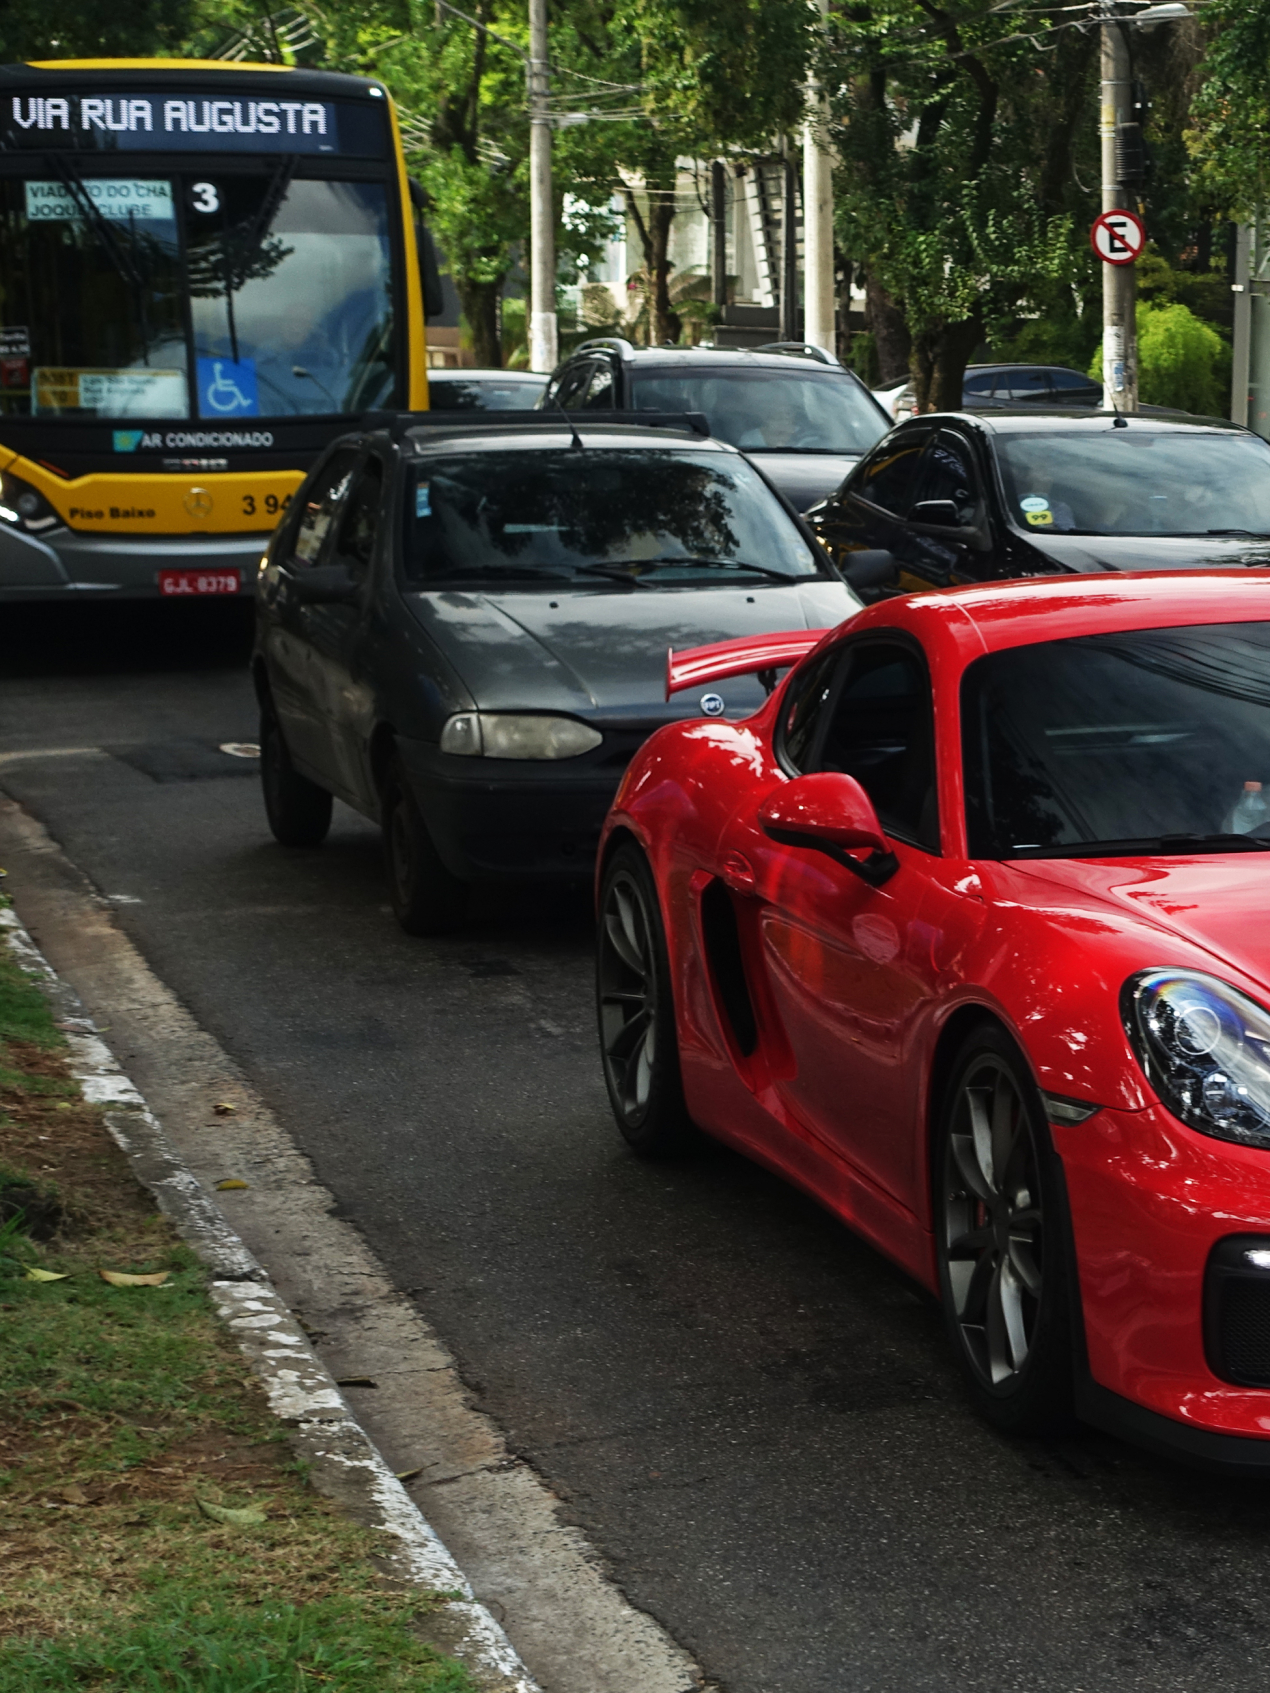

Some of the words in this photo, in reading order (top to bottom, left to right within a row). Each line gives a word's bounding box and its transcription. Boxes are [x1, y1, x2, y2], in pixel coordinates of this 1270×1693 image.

[12, 97, 70, 130] VIA
[81, 98, 153, 131] RUA
[163, 100, 327, 134] AUGUSTA
[106, 184, 130, 198] DO
[191, 182, 219, 213] 3
[1108, 221, 1127, 253] E
[141, 432, 163, 448] AR
[165, 431, 274, 448] CONDICIONADO
[69, 506, 104, 519] Piso
[109, 505, 156, 519] Baixo
[242, 494, 256, 516] 3
